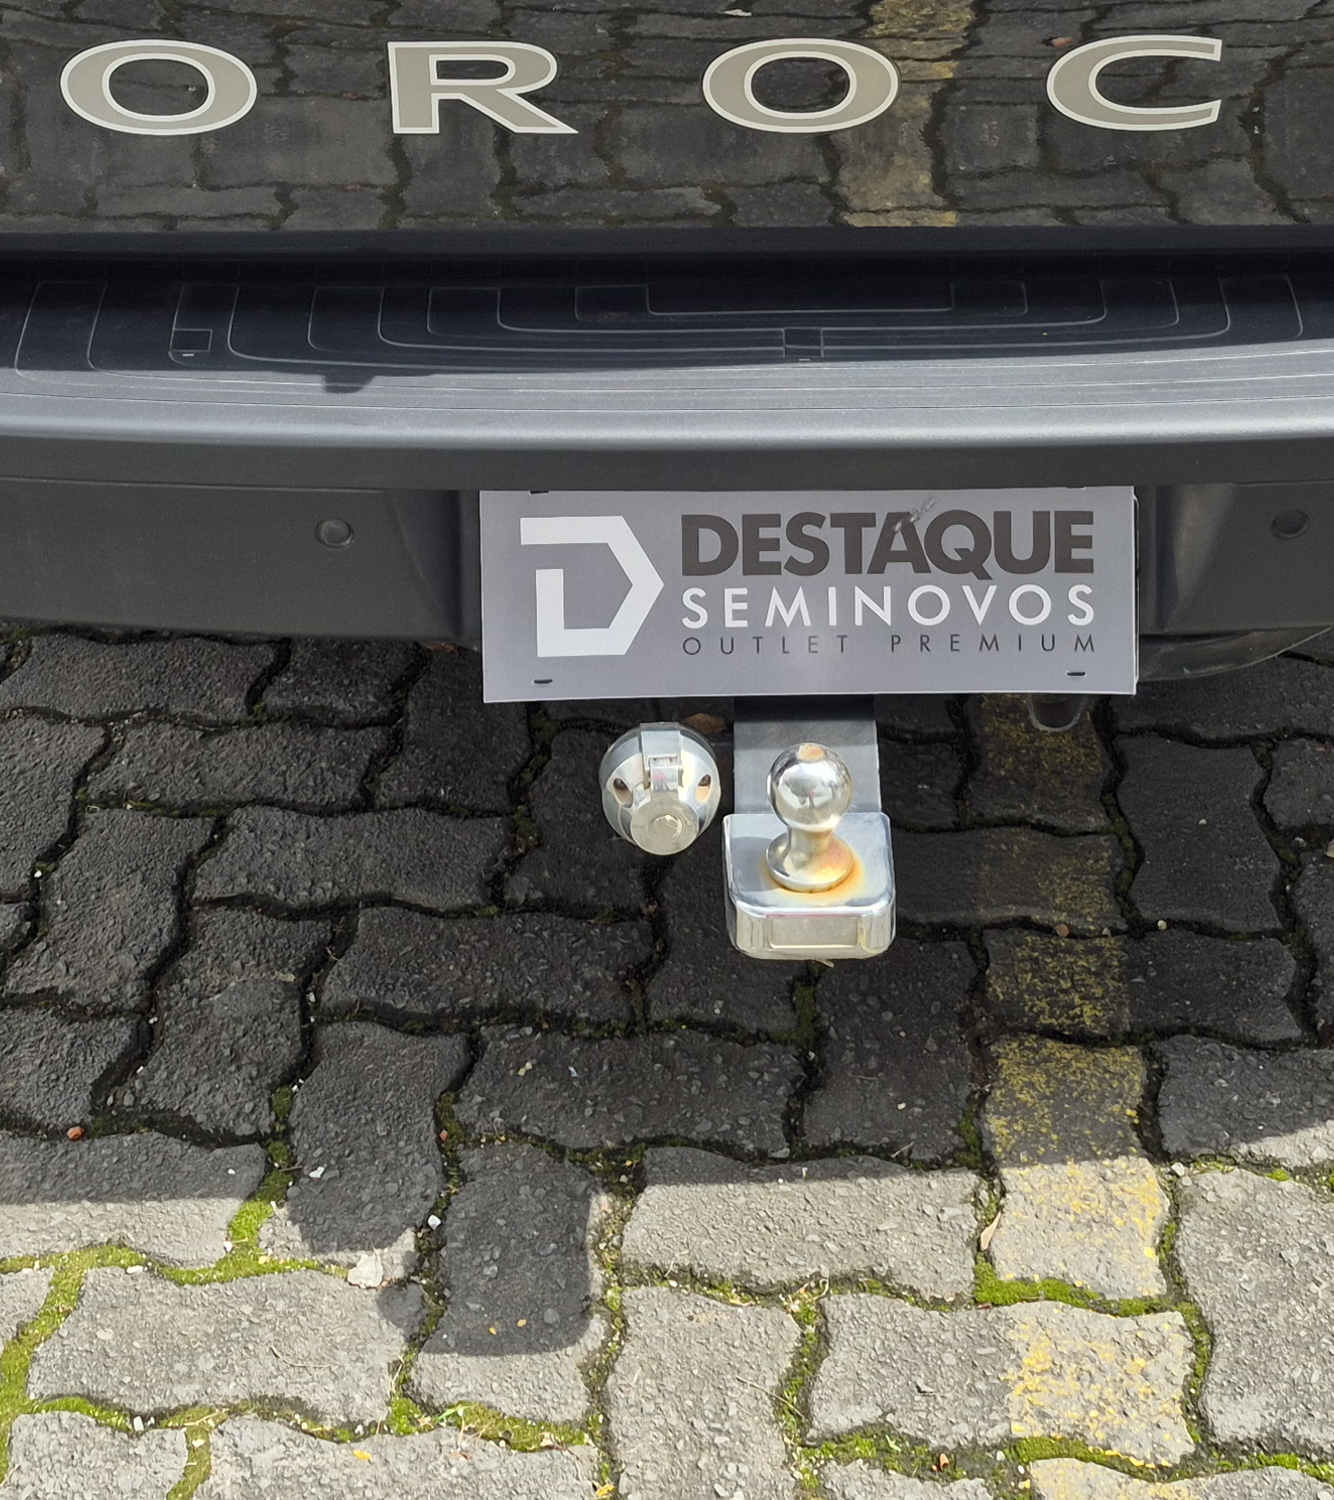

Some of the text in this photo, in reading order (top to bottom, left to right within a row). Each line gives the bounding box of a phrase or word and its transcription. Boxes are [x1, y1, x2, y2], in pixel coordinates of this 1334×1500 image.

[681, 509, 1095, 580] DESTAQUE
[681, 584, 1095, 629] SEMINOVOS
[682, 633, 1096, 656] OUTLET PREMIUM
